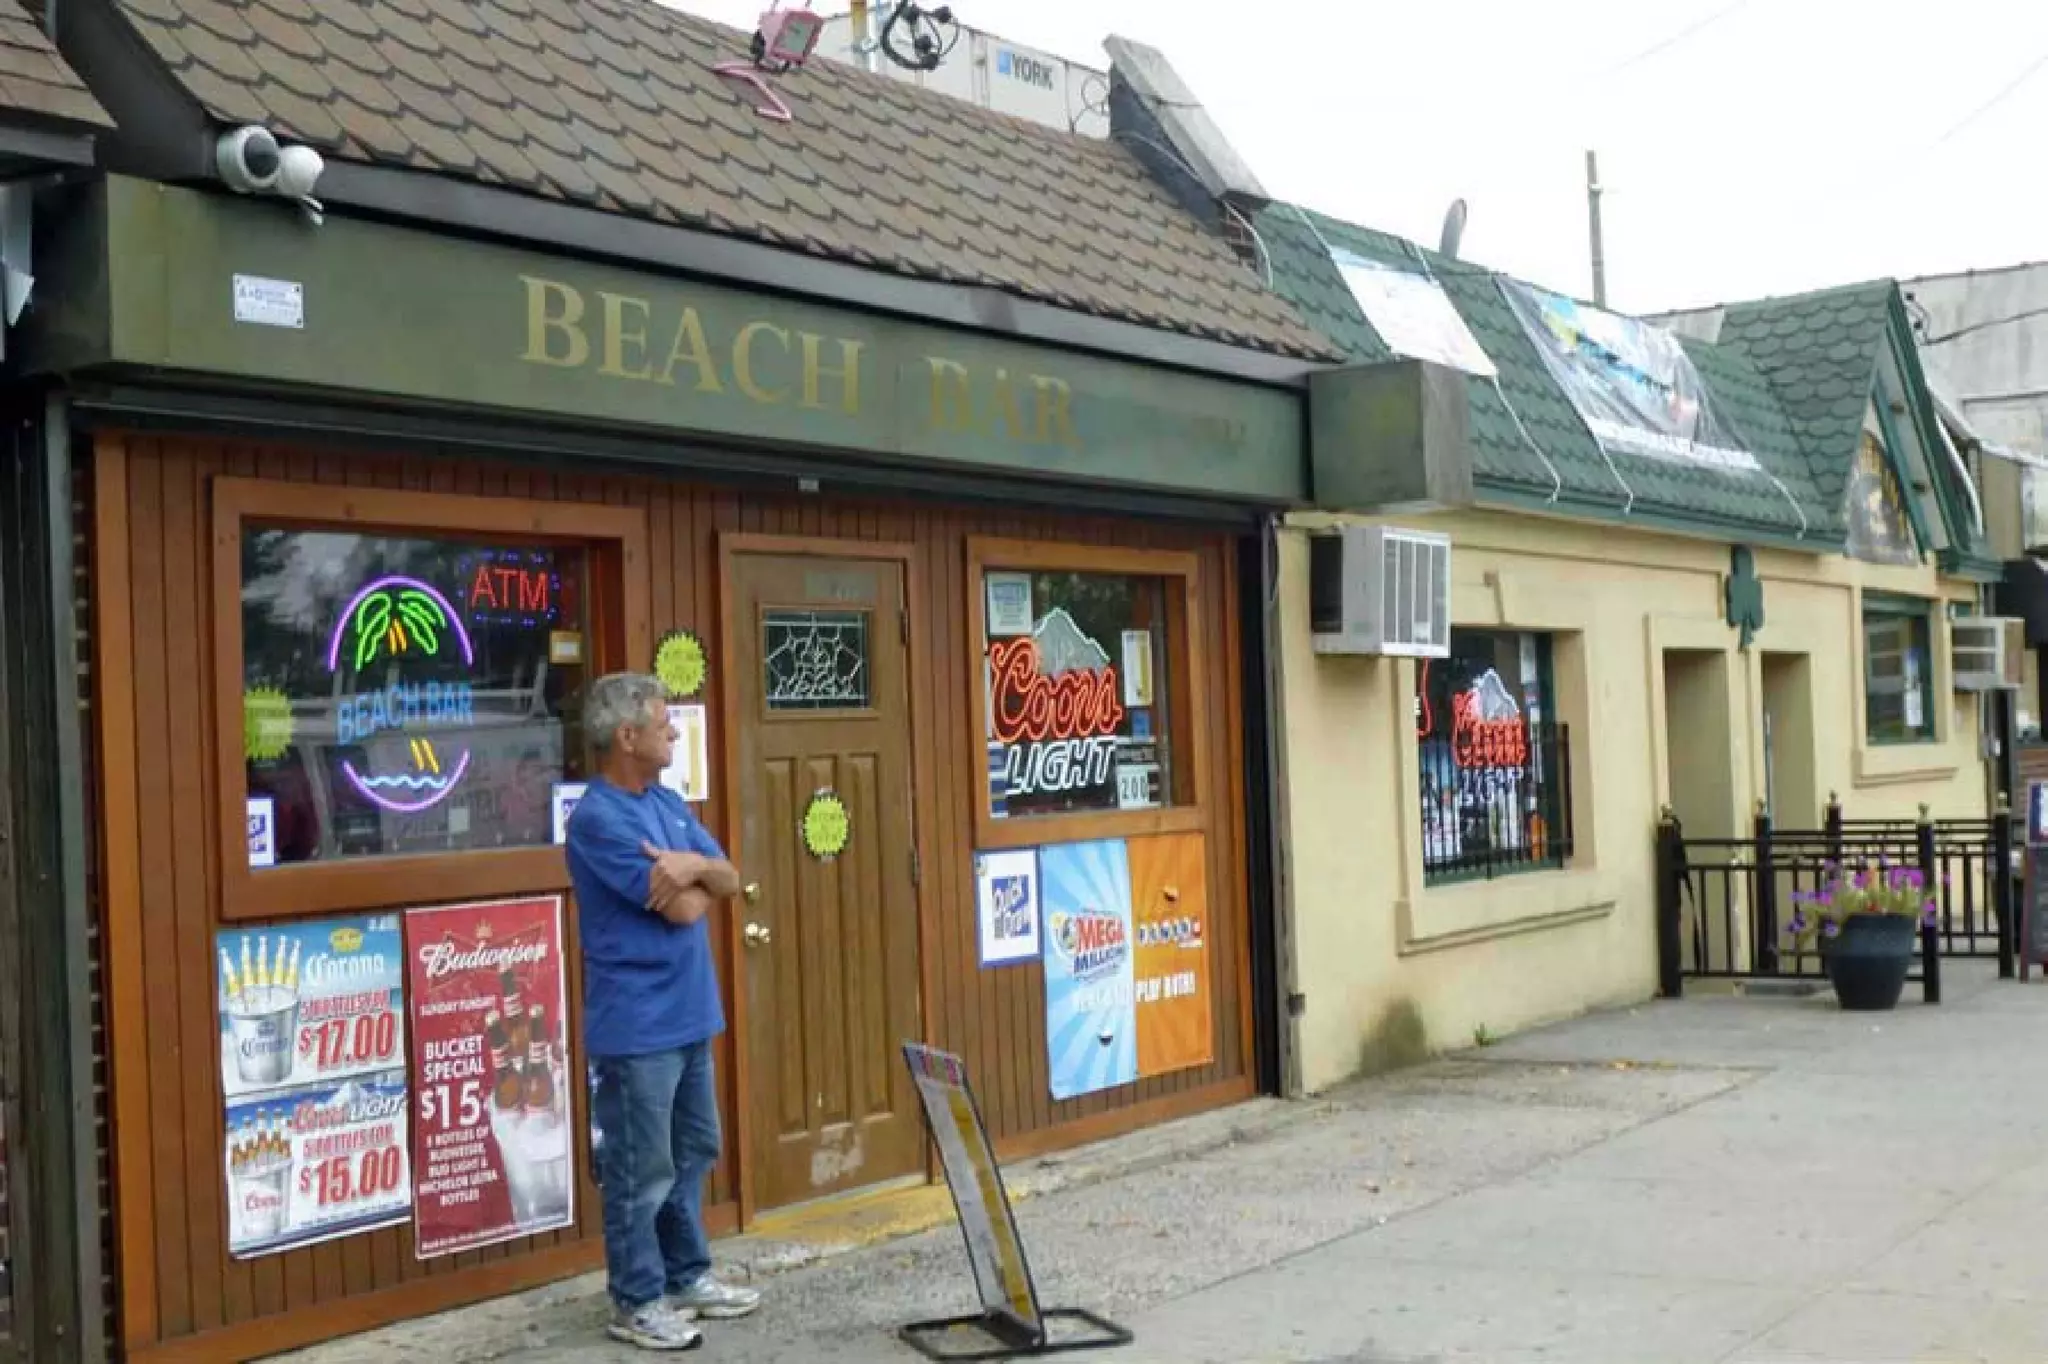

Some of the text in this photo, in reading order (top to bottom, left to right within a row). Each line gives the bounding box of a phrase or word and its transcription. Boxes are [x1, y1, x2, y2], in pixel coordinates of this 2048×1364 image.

[1012, 54, 1053, 90] YORK
[519, 274, 1082, 448] BEACH BAR
[471, 566, 548, 611] ATM
[338, 682, 421, 745] BEACH
[426, 680, 474, 725] BAR
[990, 637, 1123, 742] Coors
[1005, 735, 1117, 795] LIGHT
[420, 937, 548, 978] Budweiser
[1075, 916, 1125, 954] MEGA
[305, 952, 384, 986] Corona
[299, 1012, 394, 1070] $17.00
[424, 1034, 484, 1061] BUCKET
[424, 1056, 486, 1083] SPECIAL
[420, 1081, 480, 1130] $15
[299, 1145, 401, 1206] $15.00
